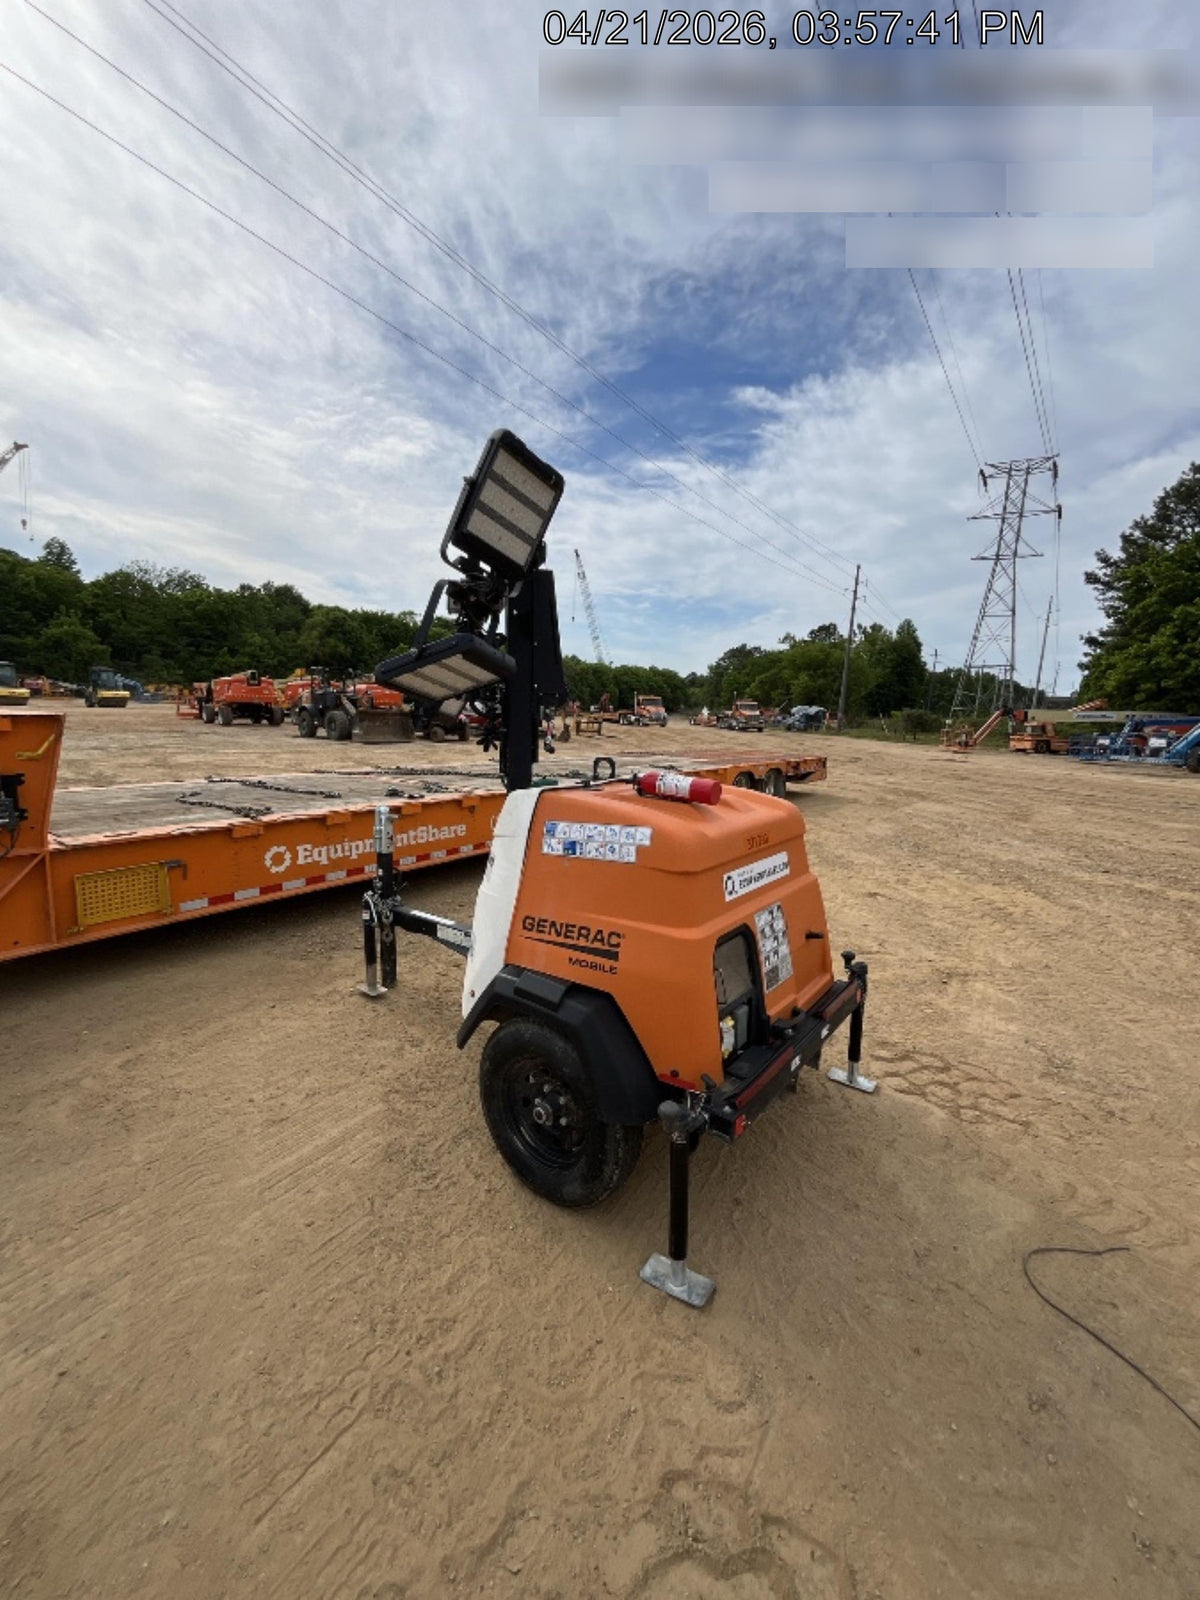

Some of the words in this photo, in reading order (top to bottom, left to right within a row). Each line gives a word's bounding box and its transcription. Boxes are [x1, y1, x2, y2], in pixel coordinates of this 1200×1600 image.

[297, 823, 467, 865] EquipntShare
[522, 915, 621, 948] GENERAC
[568, 956, 618, 975] MOBILE
